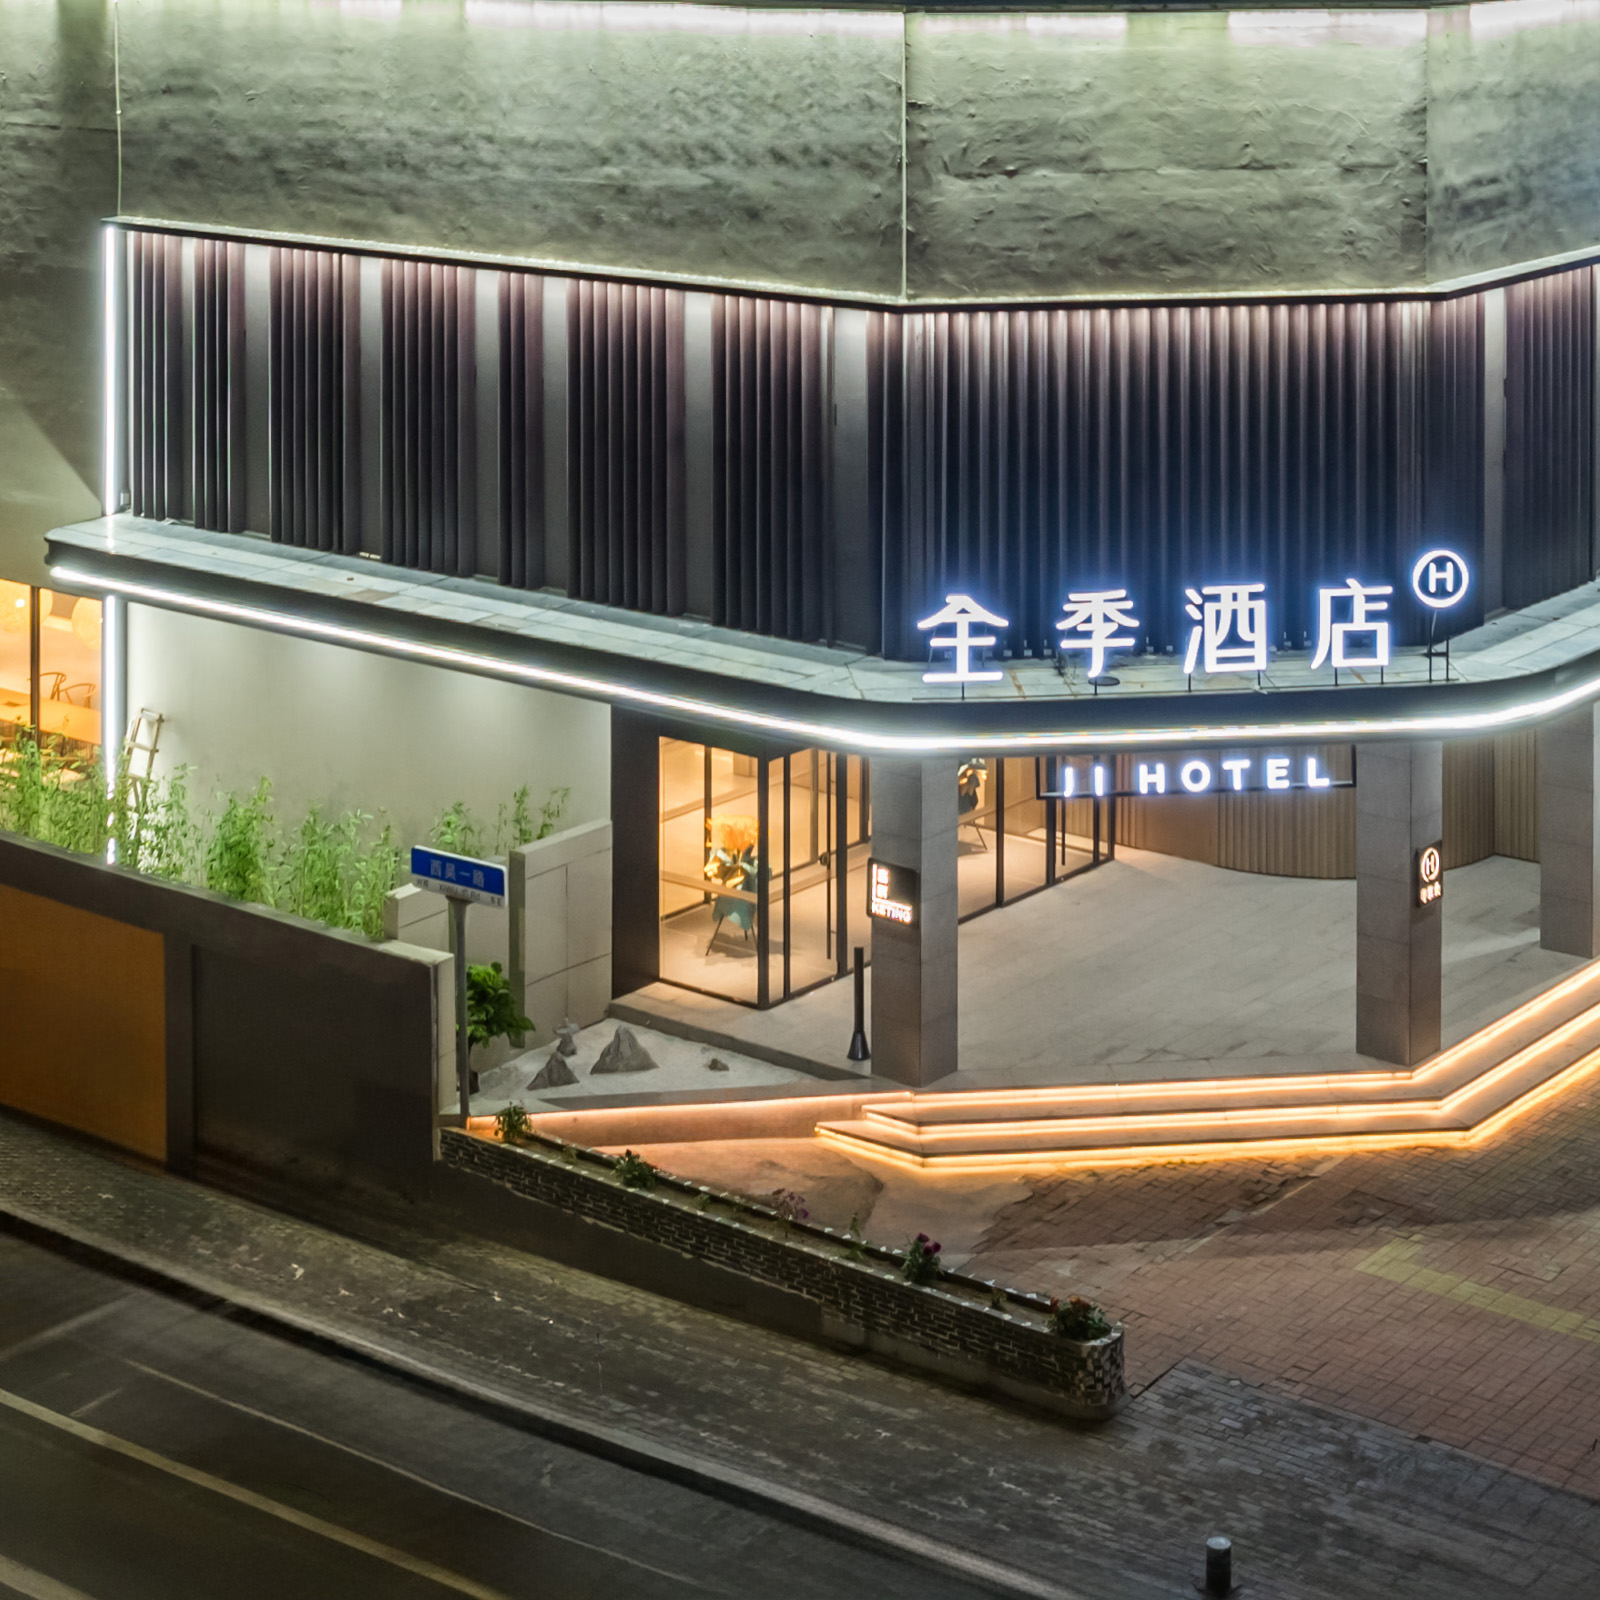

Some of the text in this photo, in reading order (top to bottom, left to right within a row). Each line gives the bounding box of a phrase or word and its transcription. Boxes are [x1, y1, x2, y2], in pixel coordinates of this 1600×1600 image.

[917, 578, 1393, 683] 全季酒店
[1063, 758, 1330, 798] JI HOTEL
